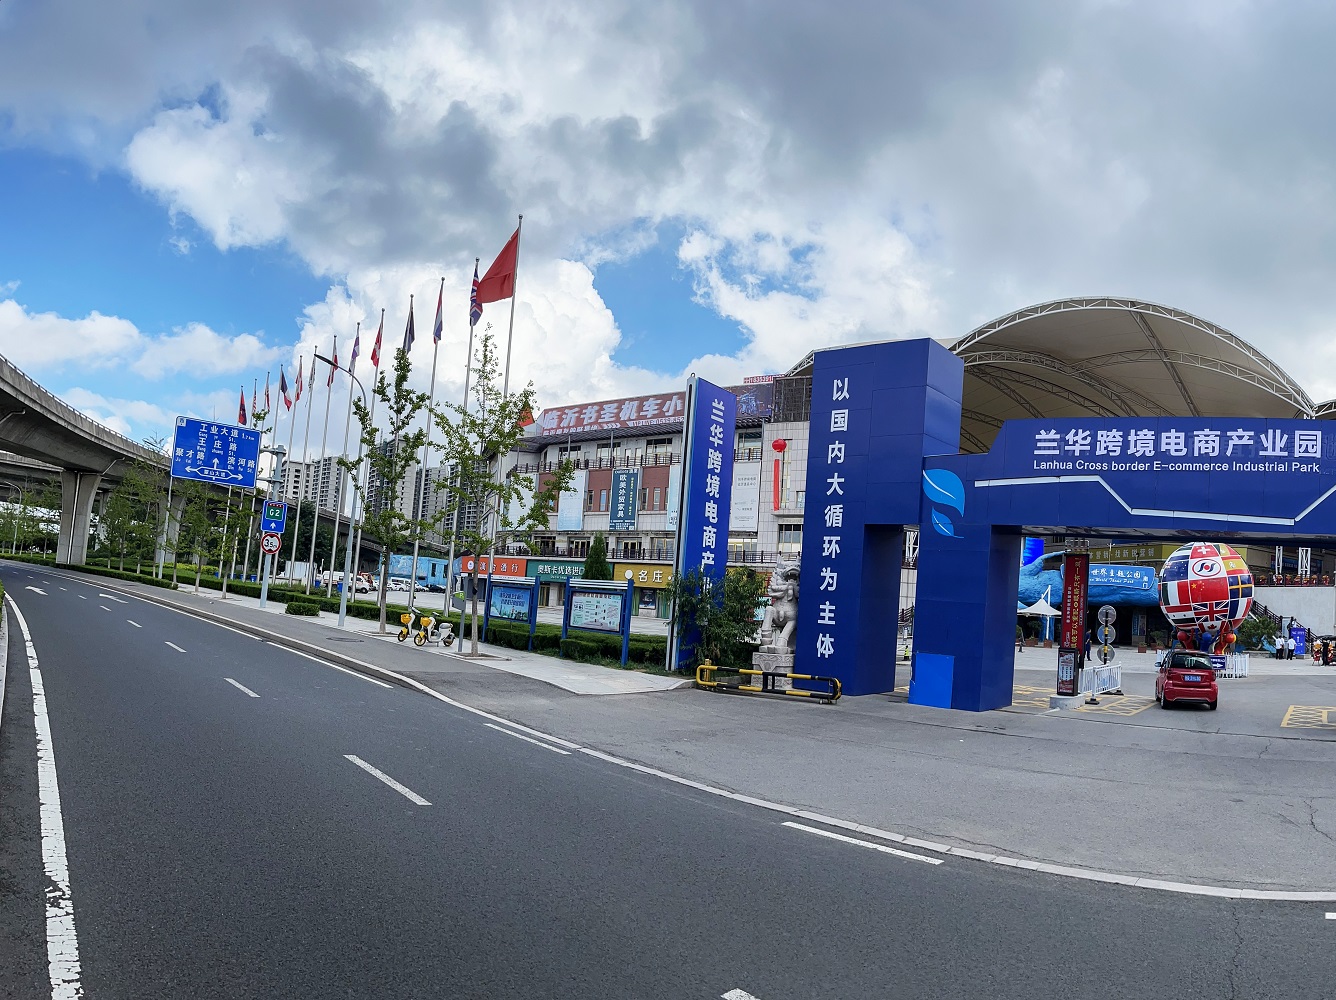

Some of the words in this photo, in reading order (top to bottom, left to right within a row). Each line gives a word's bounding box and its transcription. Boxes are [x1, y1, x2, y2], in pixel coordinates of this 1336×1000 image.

[200, 423, 239, 438] 工业大道
[198, 437, 238, 451] 王庄路
[1033, 428, 1323, 458] 兰华跨境电商产业园
[175, 447, 205, 460] 聚才路
[1033, 459, 1073, 470] Lanhua
[1076, 460, 1108, 471] Cross
[1111, 460, 1150, 471] border
[1153, 461, 1229, 472] E-commerce
[1232, 461, 1288, 472] Industrial
[1292, 462, 1320, 473] Park
[269, 508, 280, 517] G2
[816, 377, 850, 658] 以国内大循环为主体
[638, 569, 663, 583] 名庄
